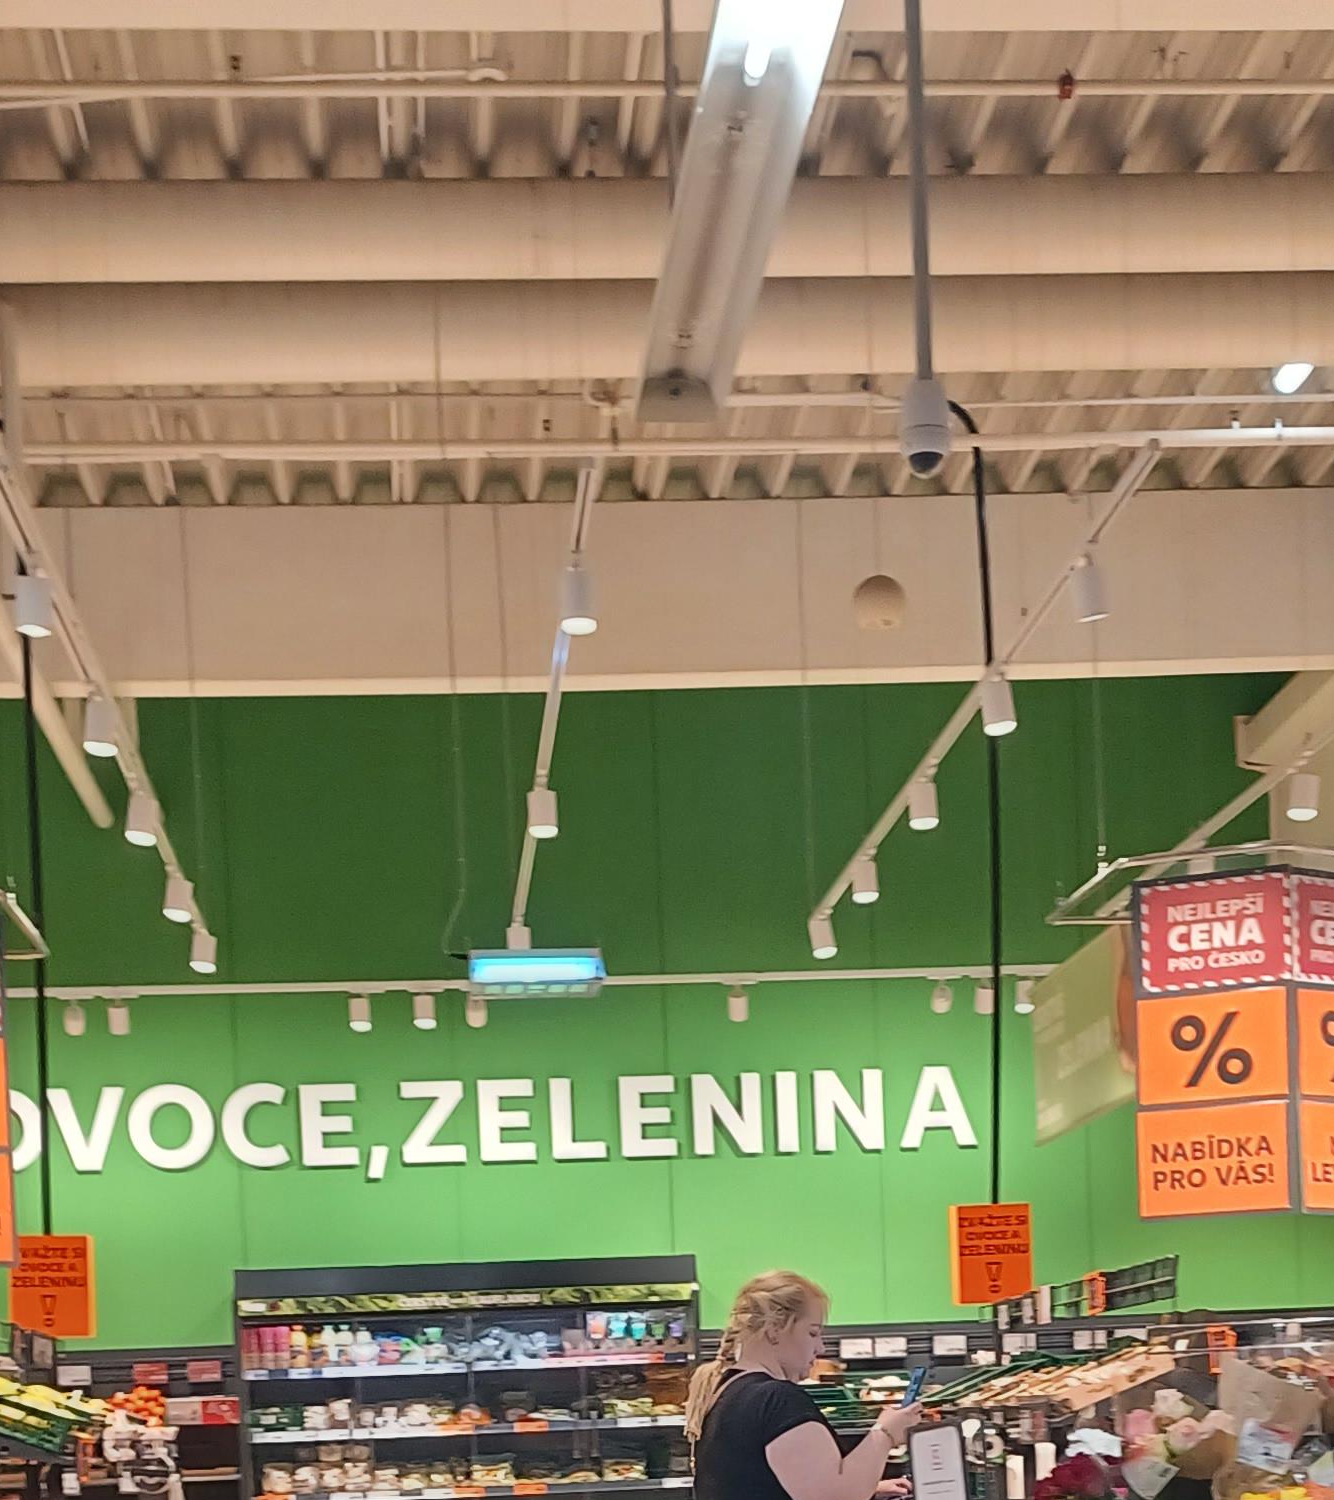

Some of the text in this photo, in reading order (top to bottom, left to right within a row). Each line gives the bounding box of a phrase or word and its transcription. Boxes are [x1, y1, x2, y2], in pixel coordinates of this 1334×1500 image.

[1167, 892, 1265, 923] NEJLEPŠÍ
[1168, 917, 1265, 952] CENA
[1167, 949, 1266, 972] PRO ČESKO
[1150, 1134, 1275, 1164] NABÍDKA
[1152, 1160, 1275, 1192] PRO VÁS!
